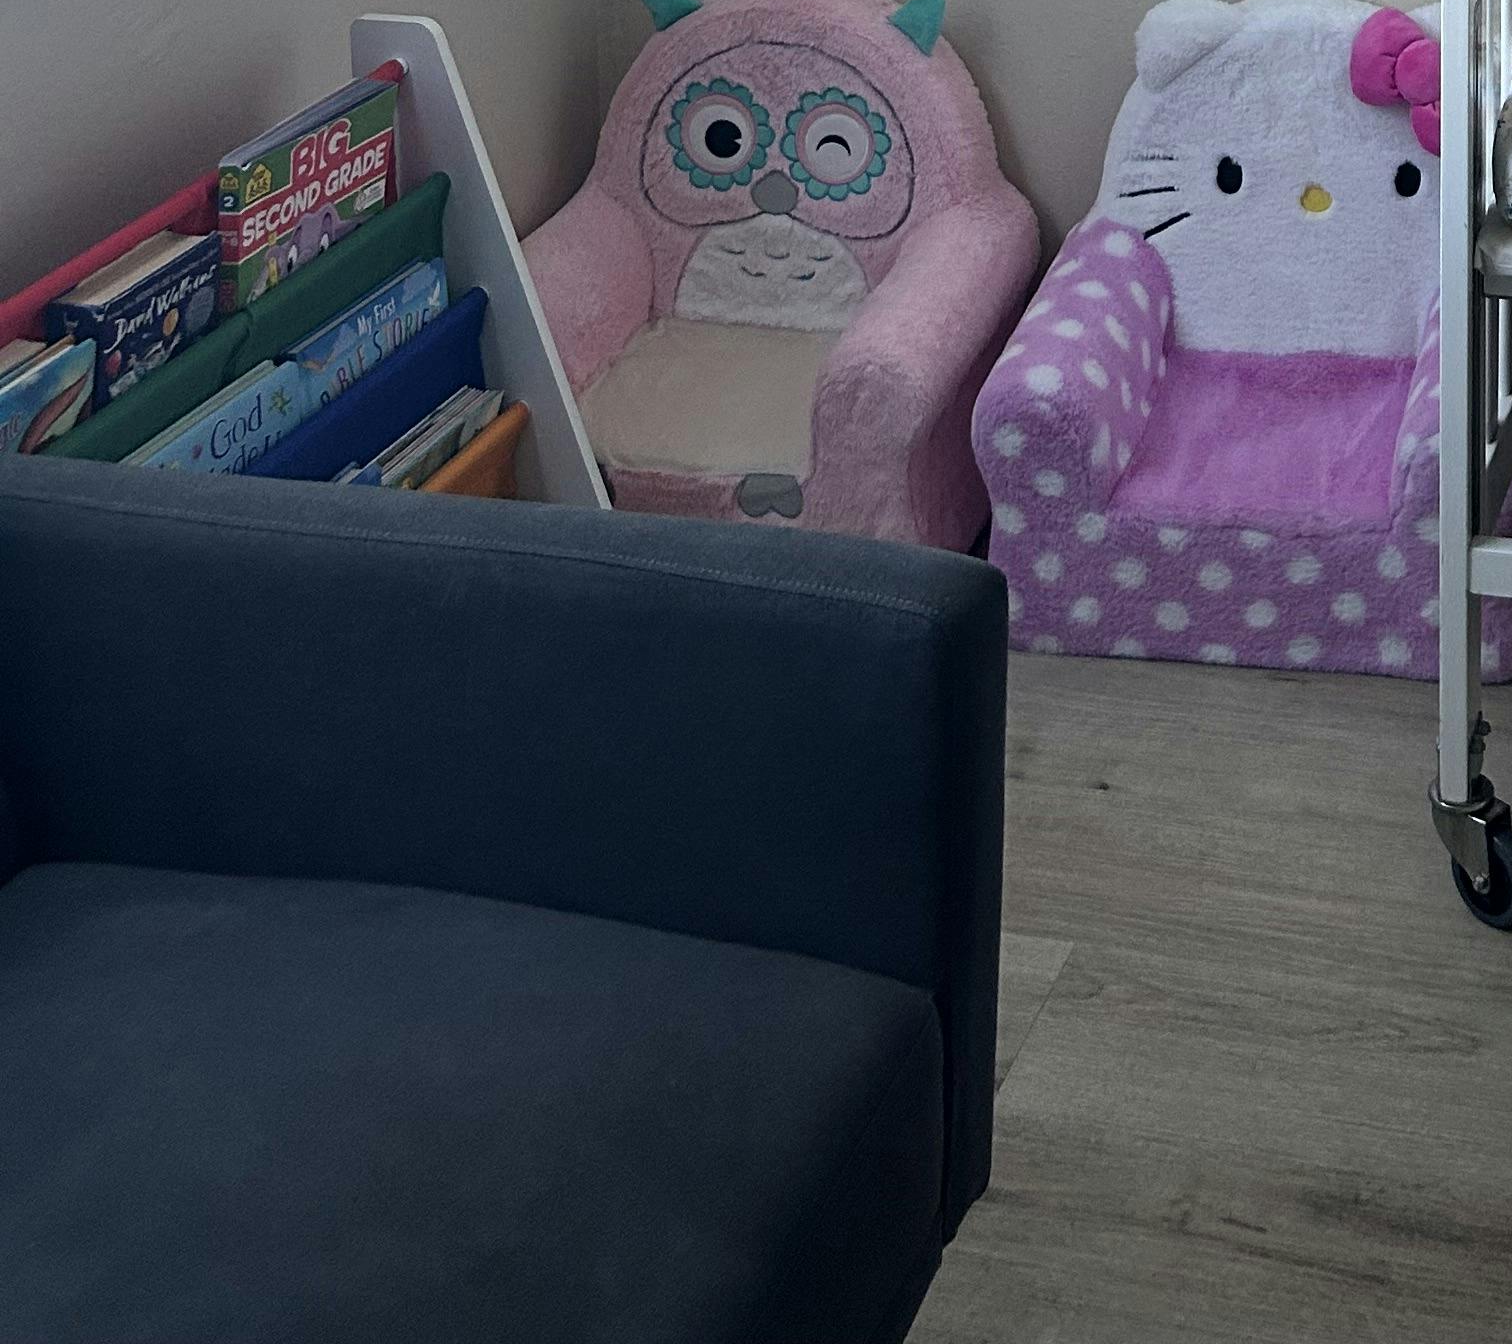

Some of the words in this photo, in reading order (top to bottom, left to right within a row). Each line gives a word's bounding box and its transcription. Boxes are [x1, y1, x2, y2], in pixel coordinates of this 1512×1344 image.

[291, 118, 352, 178] BIG
[223, 197, 234, 207] 2
[242, 181, 321, 247] SECOND
[324, 142, 387, 196] GRADE
[357, 315, 372, 336] My
[374, 297, 395, 324] First
[211, 392, 262, 459] God
